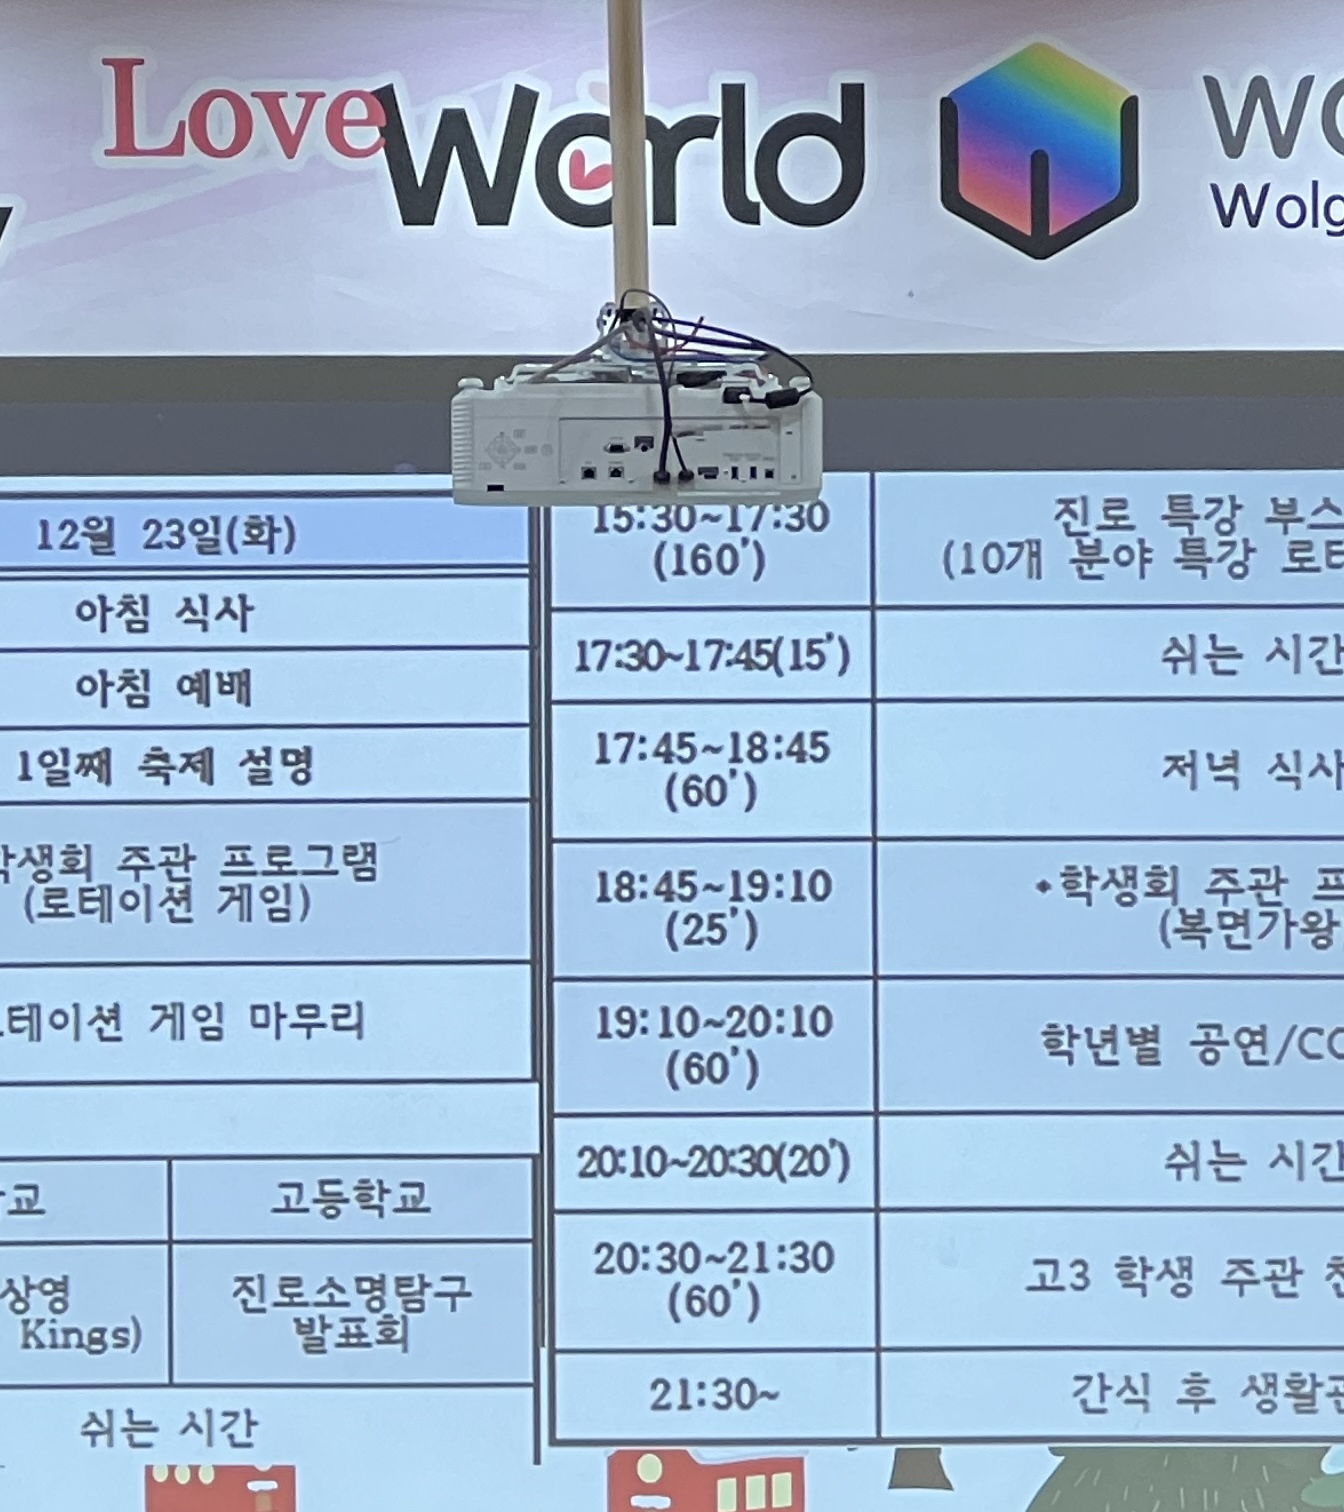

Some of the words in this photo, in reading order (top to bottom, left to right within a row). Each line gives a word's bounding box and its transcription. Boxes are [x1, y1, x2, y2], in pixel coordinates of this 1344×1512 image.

[102, 57, 388, 159] Love
[37, 515, 116, 557] 12월
[142, 514, 296, 556] 23일(화)
[1053, 494, 1137, 538] 진로
[1160, 493, 1245, 537] 특강
[943, 538, 1043, 581] (10개
[1068, 537, 1154, 581] 분야
[1172, 537, 1258, 581] 특강
[75, 593, 150, 634] 아침
[175, 593, 256, 634] 식사
[1161, 633, 1244, 677] 쉬는
[76, 668, 151, 710] 아침
[176, 667, 252, 709] 예배
[17, 746, 113, 788] 1일째
[137, 745, 215, 787] 축제
[238, 745, 313, 787] 설명
[595, 730, 831, 765] 17:45~18:45
[1162, 749, 1240, 792] 저녁
[116, 842, 197, 884] 주관
[219, 841, 377, 883] 프로그램
[24, 883, 195, 924] (로테이션
[216, 882, 311, 924] 게임)
[596, 868, 833, 904] 18:45~19:10
[1059, 864, 1179, 908] 학생회
[1203, 864, 1290, 907] 주관
[149, 1001, 224, 1042] 게임
[249, 1000, 364, 1041] 마무리
[596, 1004, 834, 1040] 19:10~20:10
[1040, 1022, 1162, 1067] 학년별
[1164, 1139, 1248, 1183] 쉬는
[270, 1178, 432, 1220] 고등학교
[594, 1240, 835, 1275] 20:30~21:30
[1025, 1258, 1091, 1292] 고3
[1114, 1255, 1193, 1299] 학생
[1220, 1255, 1305, 1299] 주관
[232, 1273, 473, 1314] 진로소명탐구
[20, 1314, 142, 1356] Kings)
[292, 1313, 409, 1355] 발표회
[650, 1377, 780, 1412] 21:30~
[1072, 1371, 1150, 1415] 간식
[1176, 1371, 1217, 1415] 후
[80, 1407, 160, 1449] 쉬는
[179, 1407, 260, 1449] 시간
